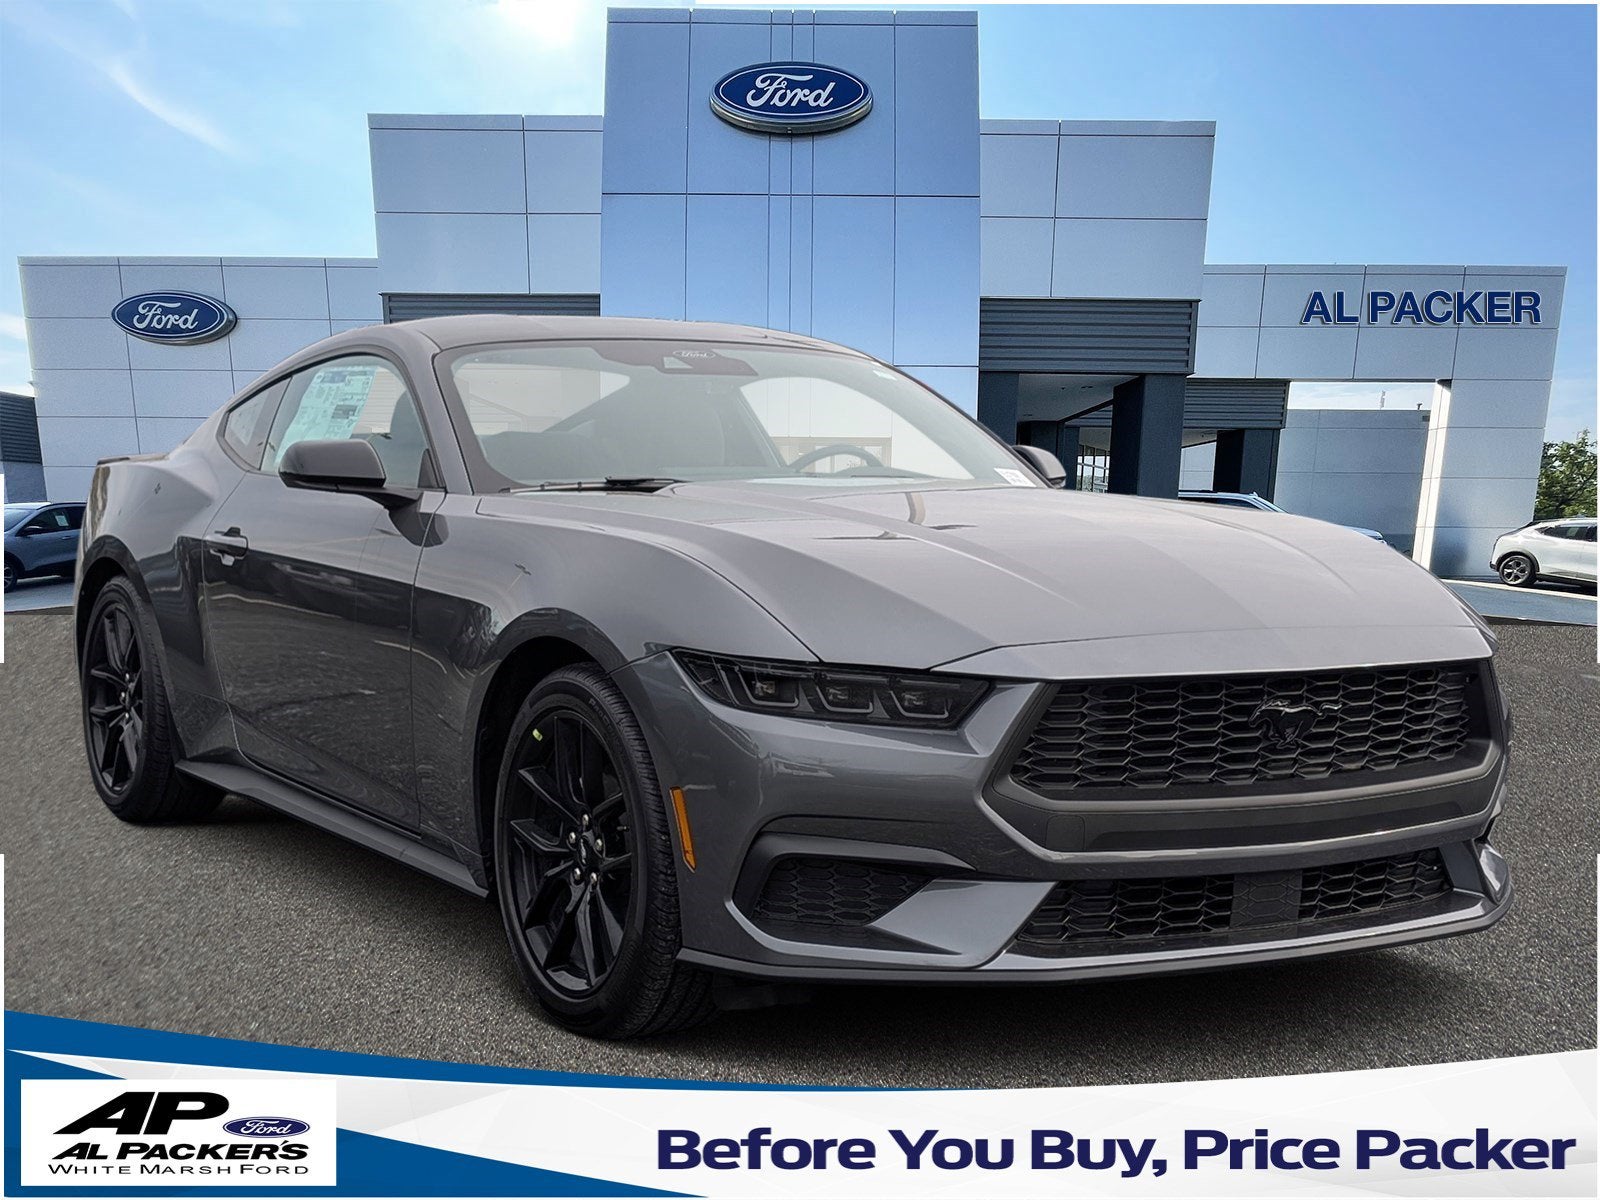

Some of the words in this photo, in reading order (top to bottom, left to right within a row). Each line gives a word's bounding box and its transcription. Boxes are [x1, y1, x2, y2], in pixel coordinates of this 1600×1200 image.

[746, 73, 836, 107] Ford
[133, 301, 198, 329] Ford
[1301, 290, 1360, 324] AL
[1369, 289, 1542, 325] PACKER
